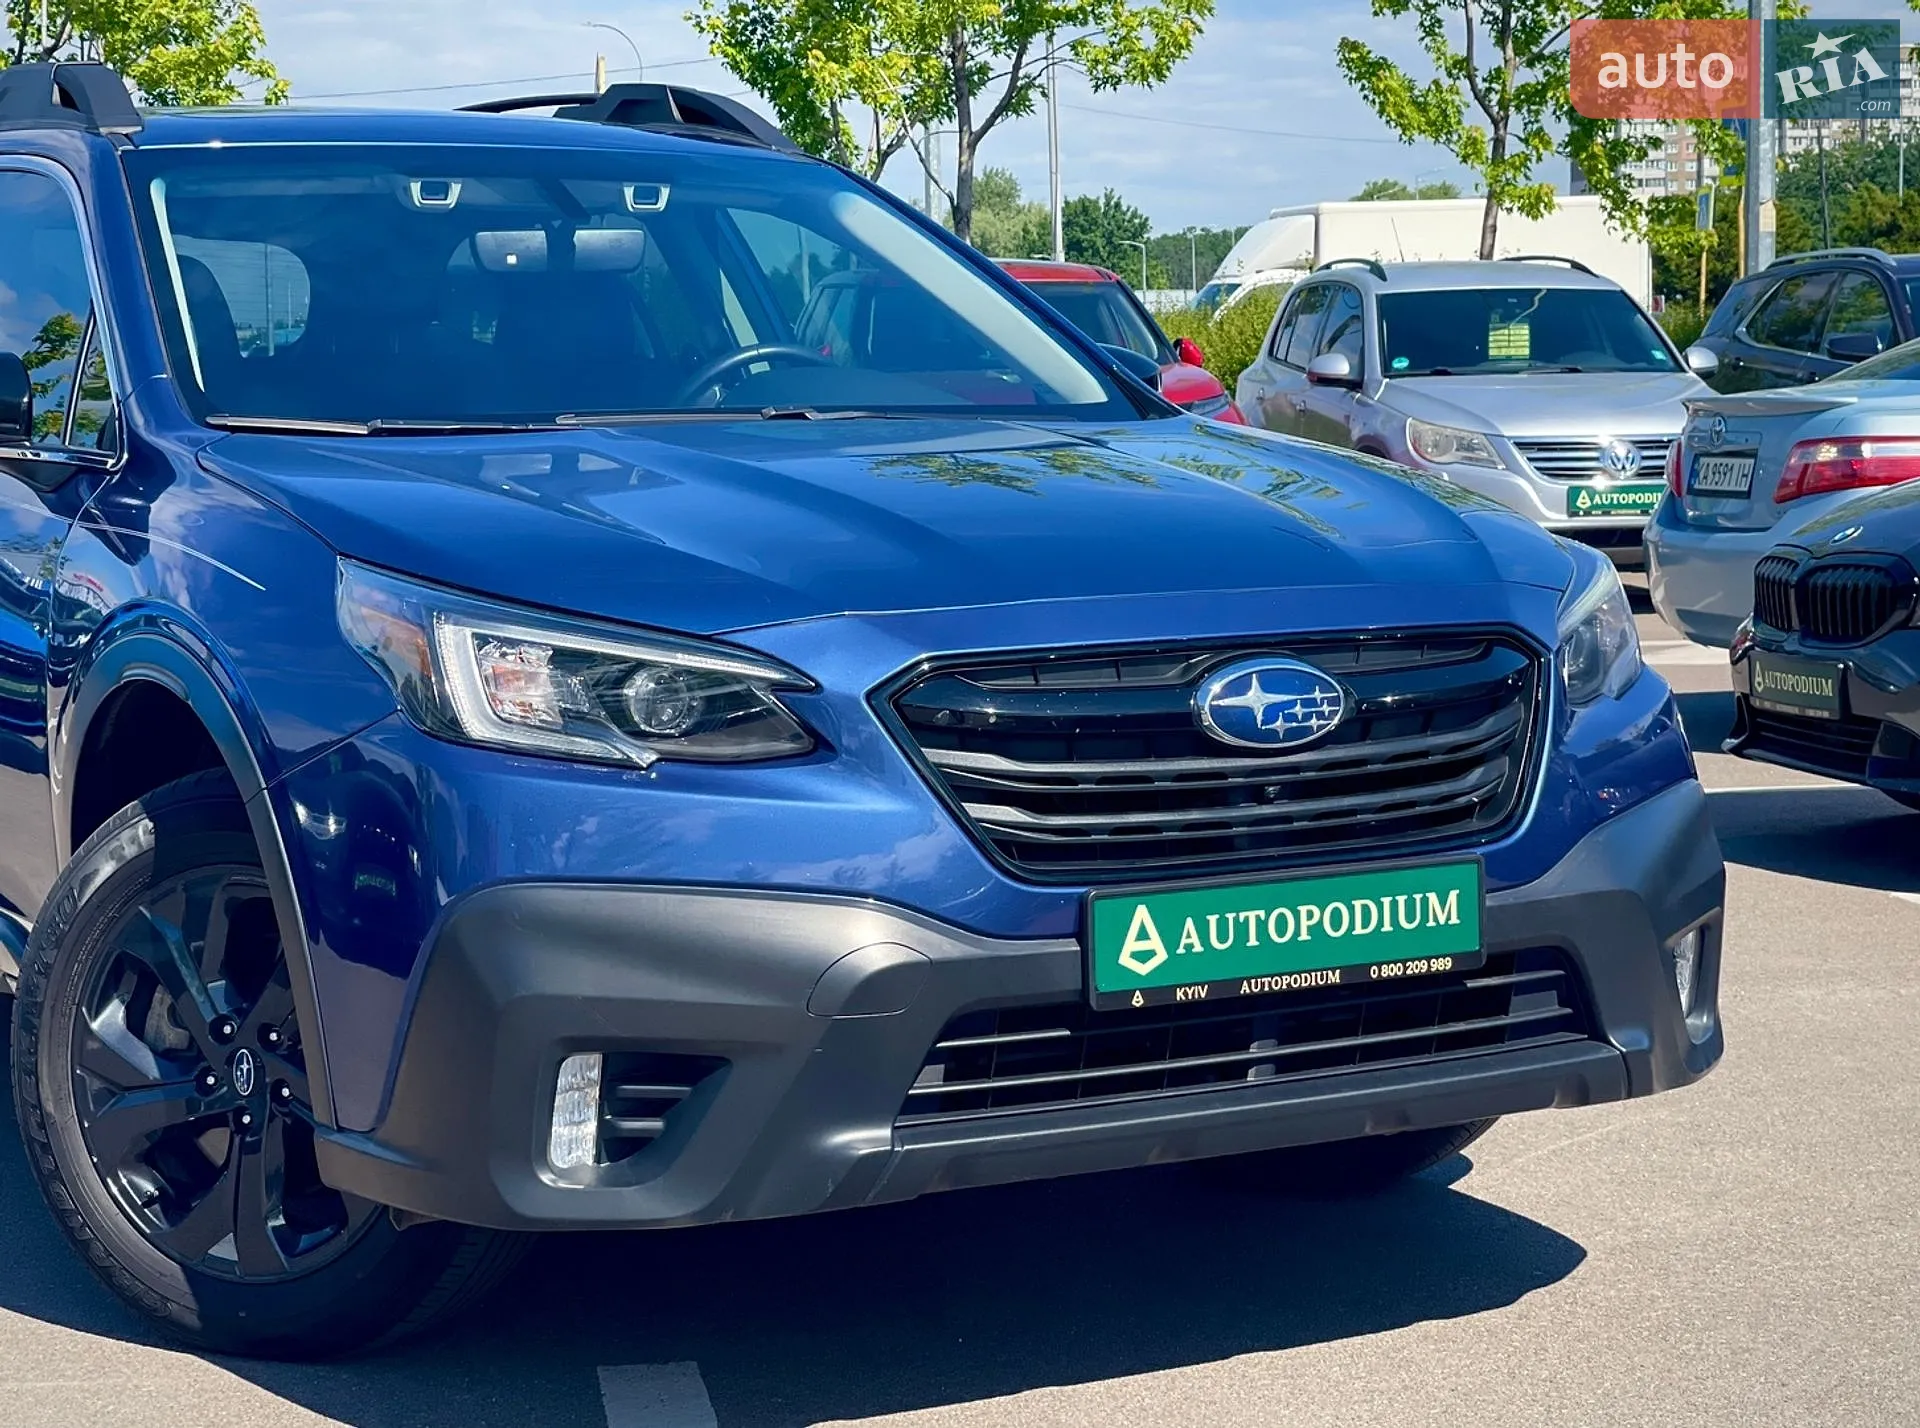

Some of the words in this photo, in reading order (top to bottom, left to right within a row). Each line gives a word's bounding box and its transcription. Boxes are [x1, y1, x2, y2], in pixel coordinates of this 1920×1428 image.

[1764, 671, 1833, 697] AUTOPODIUM
[1175, 888, 1461, 955] AUTOPODIUM
[1176, 984, 1209, 1002] KYIV
[1239, 969, 1341, 994] AUTOPODIUM
[1370, 965, 1379, 979] 0
[1381, 962, 1404, 978] 800
[1405, 959, 1428, 975] 209
[1430, 957, 1453, 972] 989
